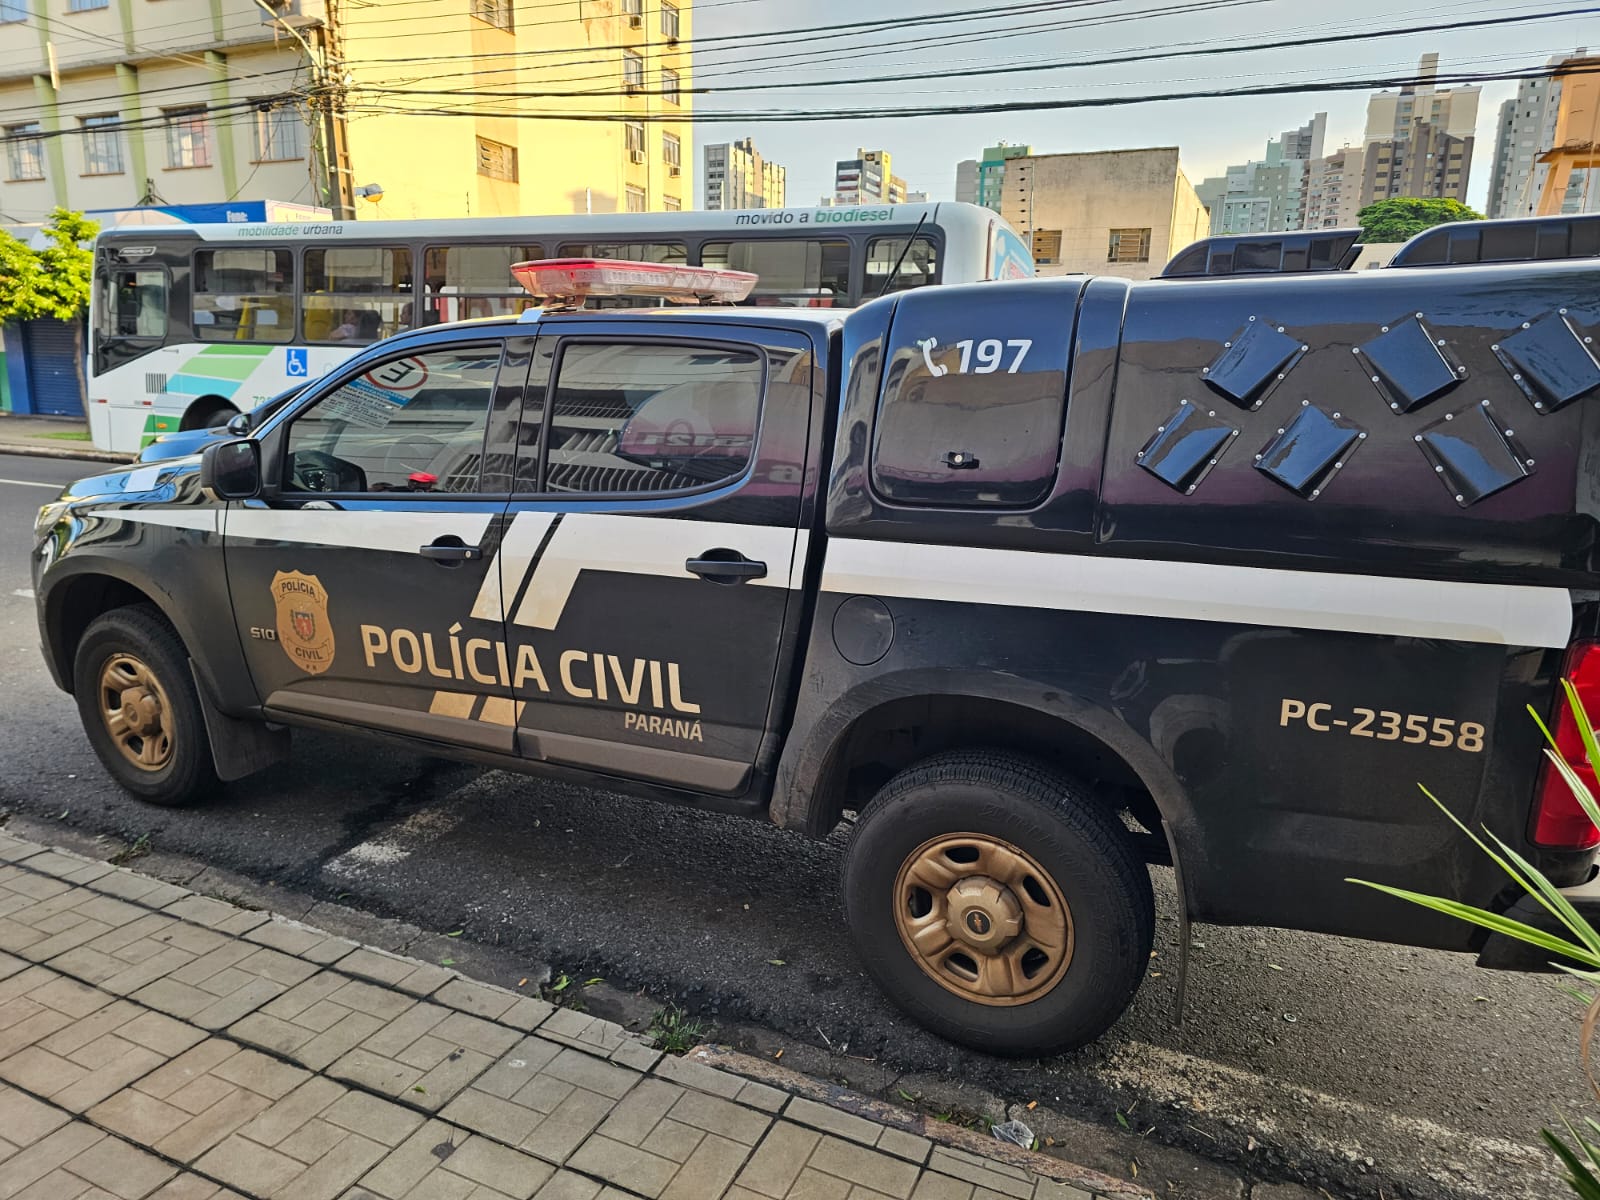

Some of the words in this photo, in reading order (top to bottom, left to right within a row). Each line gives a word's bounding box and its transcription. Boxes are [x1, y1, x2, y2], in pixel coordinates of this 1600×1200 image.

[238, 224, 299, 237] mobilidade
[302, 223, 343, 235] urbana
[735, 211, 794, 225] movido
[799, 212, 809, 223] a
[814, 207, 895, 223] biodiesel
[956, 339, 1033, 374] 197
[295, 647, 324, 660] CIVIL
[360, 621, 551, 693] POLÍCIA
[559, 649, 701, 714] CIVIL
[623, 711, 704, 742] PARANÁ
[1279, 698, 1486, 753] PC-23558
